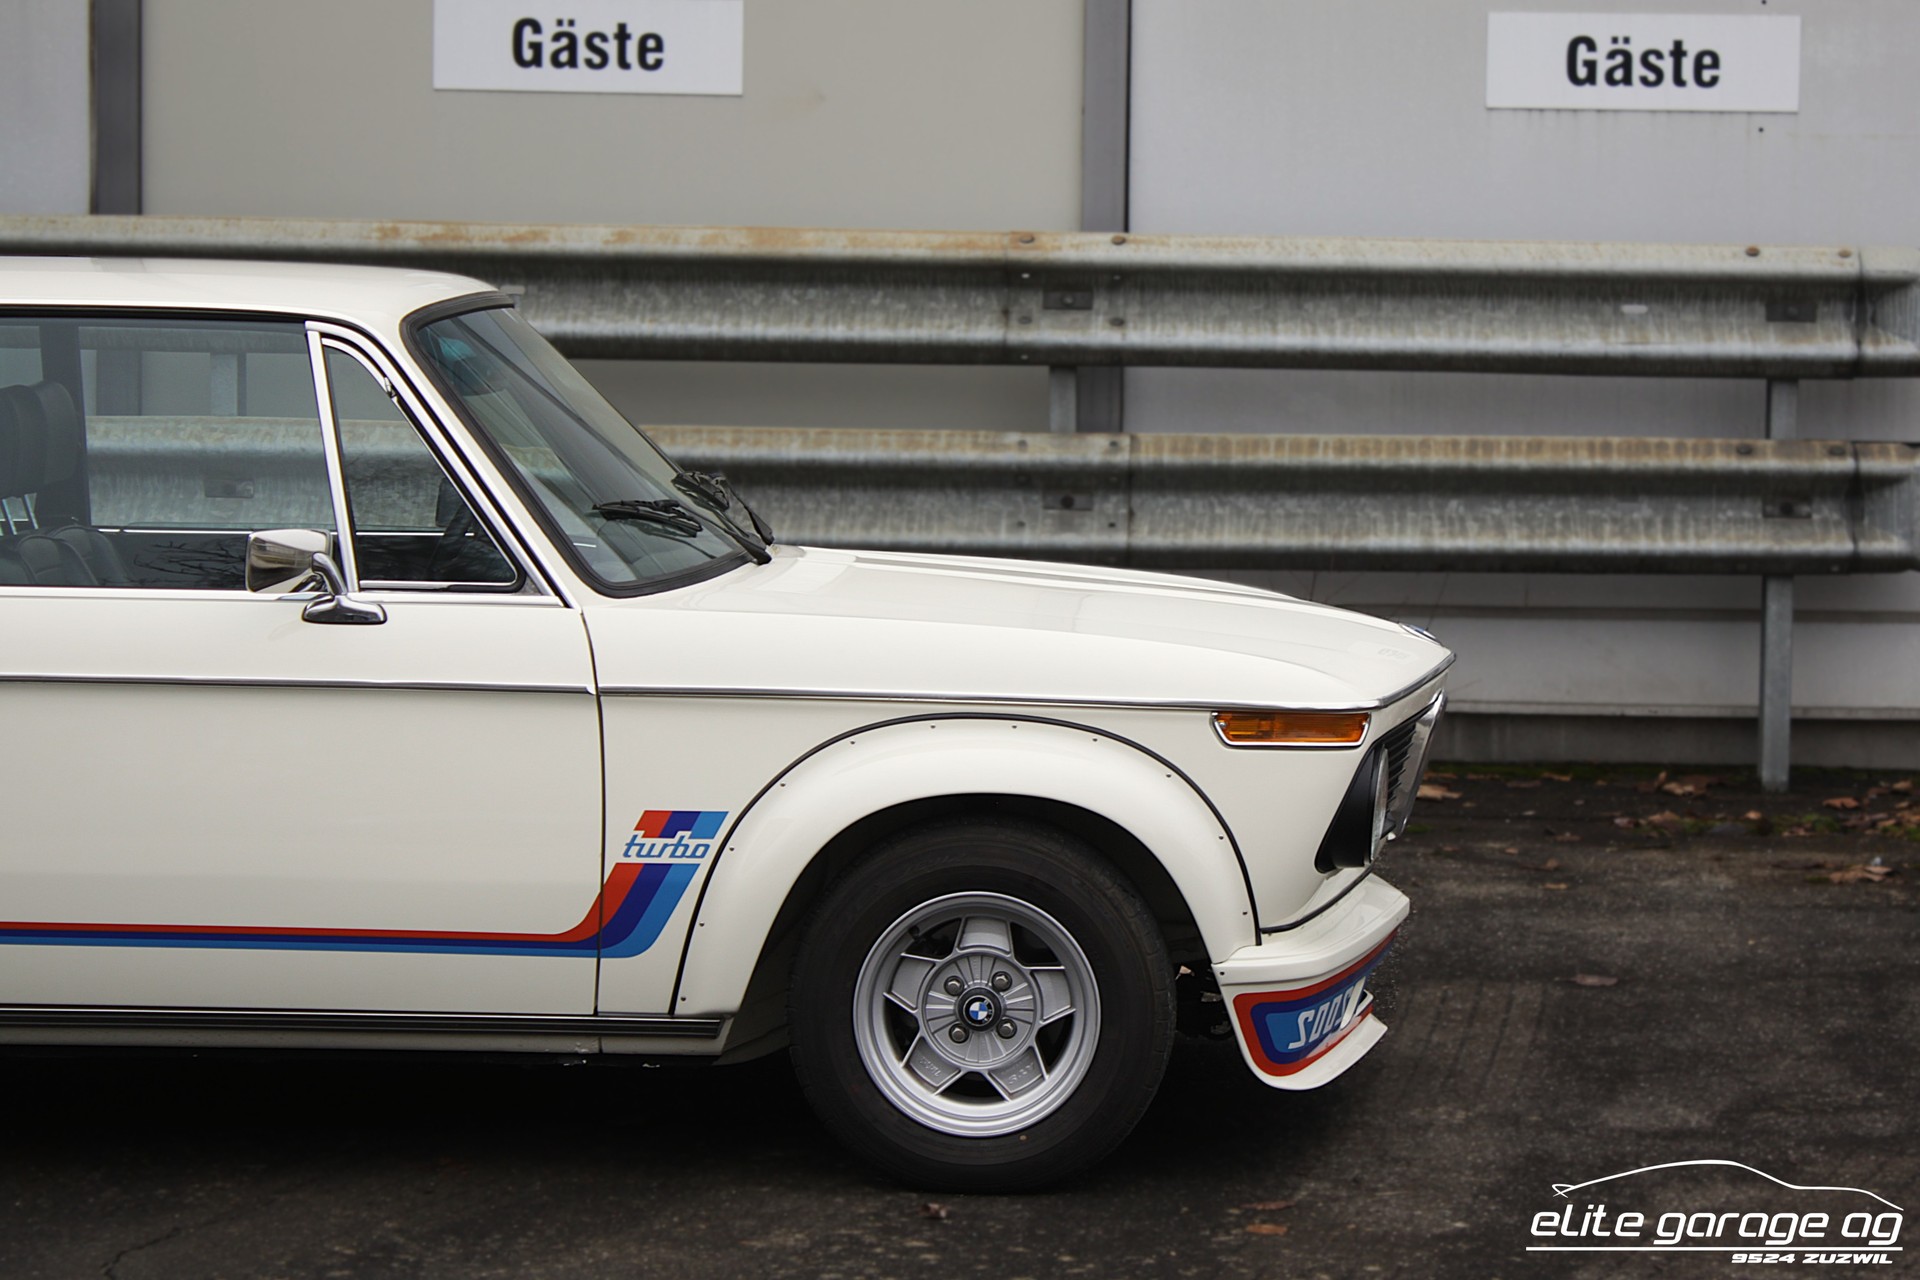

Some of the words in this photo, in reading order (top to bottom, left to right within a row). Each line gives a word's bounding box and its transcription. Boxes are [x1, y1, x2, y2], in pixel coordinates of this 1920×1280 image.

[511, 17, 664, 71] Gäste
[1566, 35, 1720, 88] Gäste
[622, 834, 711, 858] turbo
